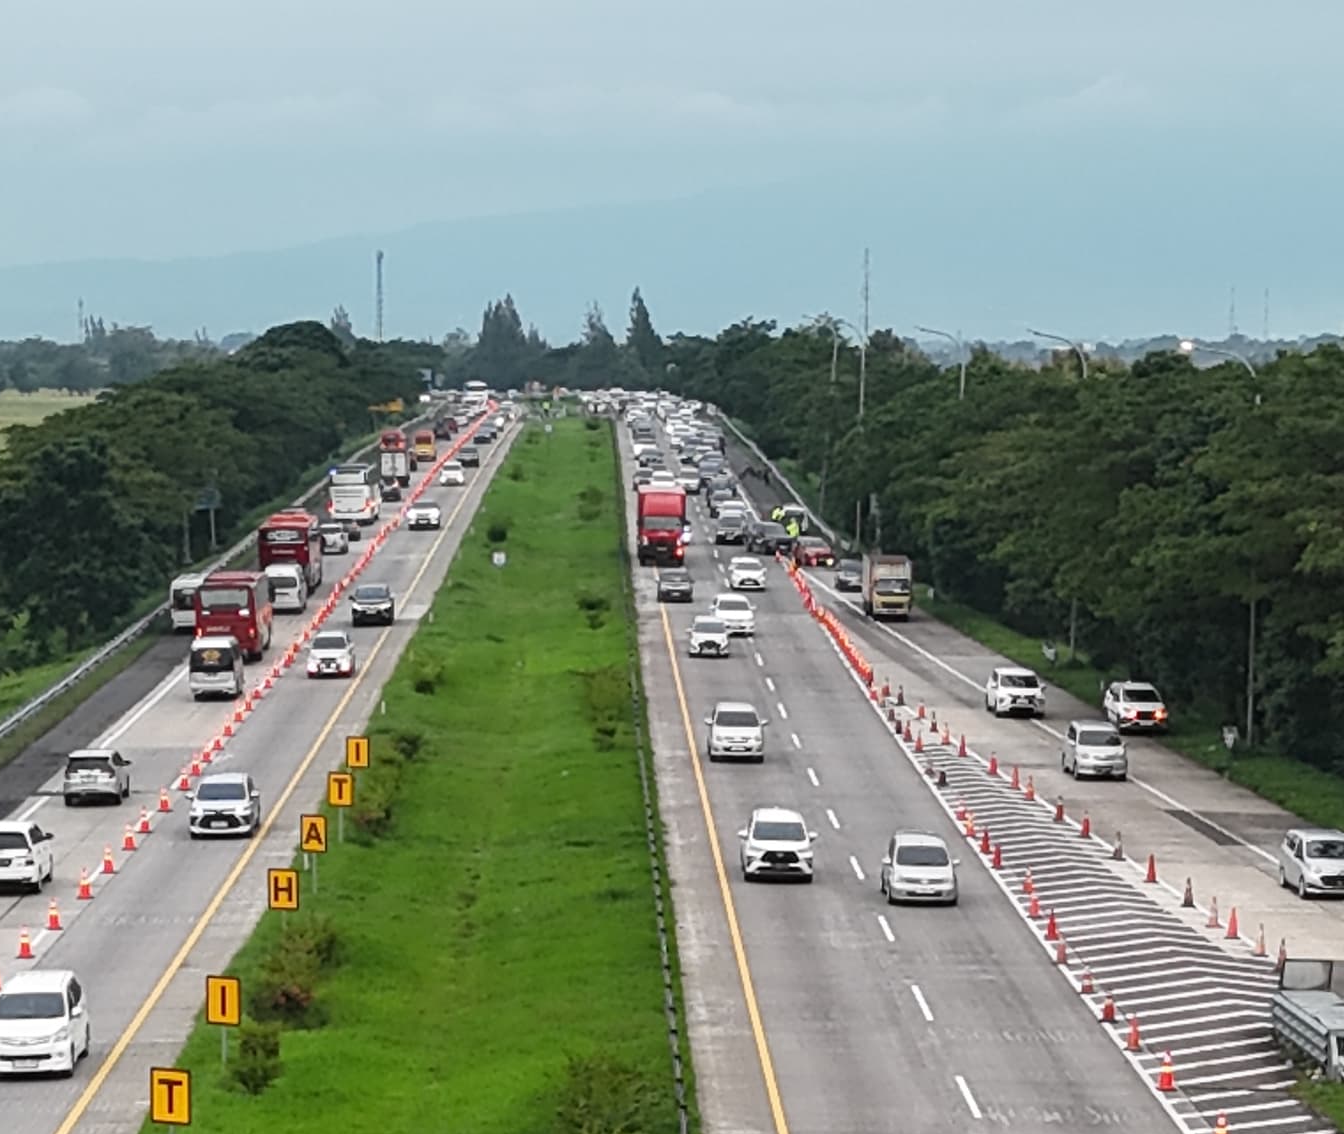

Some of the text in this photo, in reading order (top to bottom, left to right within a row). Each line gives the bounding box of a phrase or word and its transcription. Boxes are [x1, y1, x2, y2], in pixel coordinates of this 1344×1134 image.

[333, 778, 348, 800] T
[303, 823, 324, 845] A
[274, 876, 292, 902] H
[220, 986, 227, 1017] I
[158, 1079, 182, 1113] T
